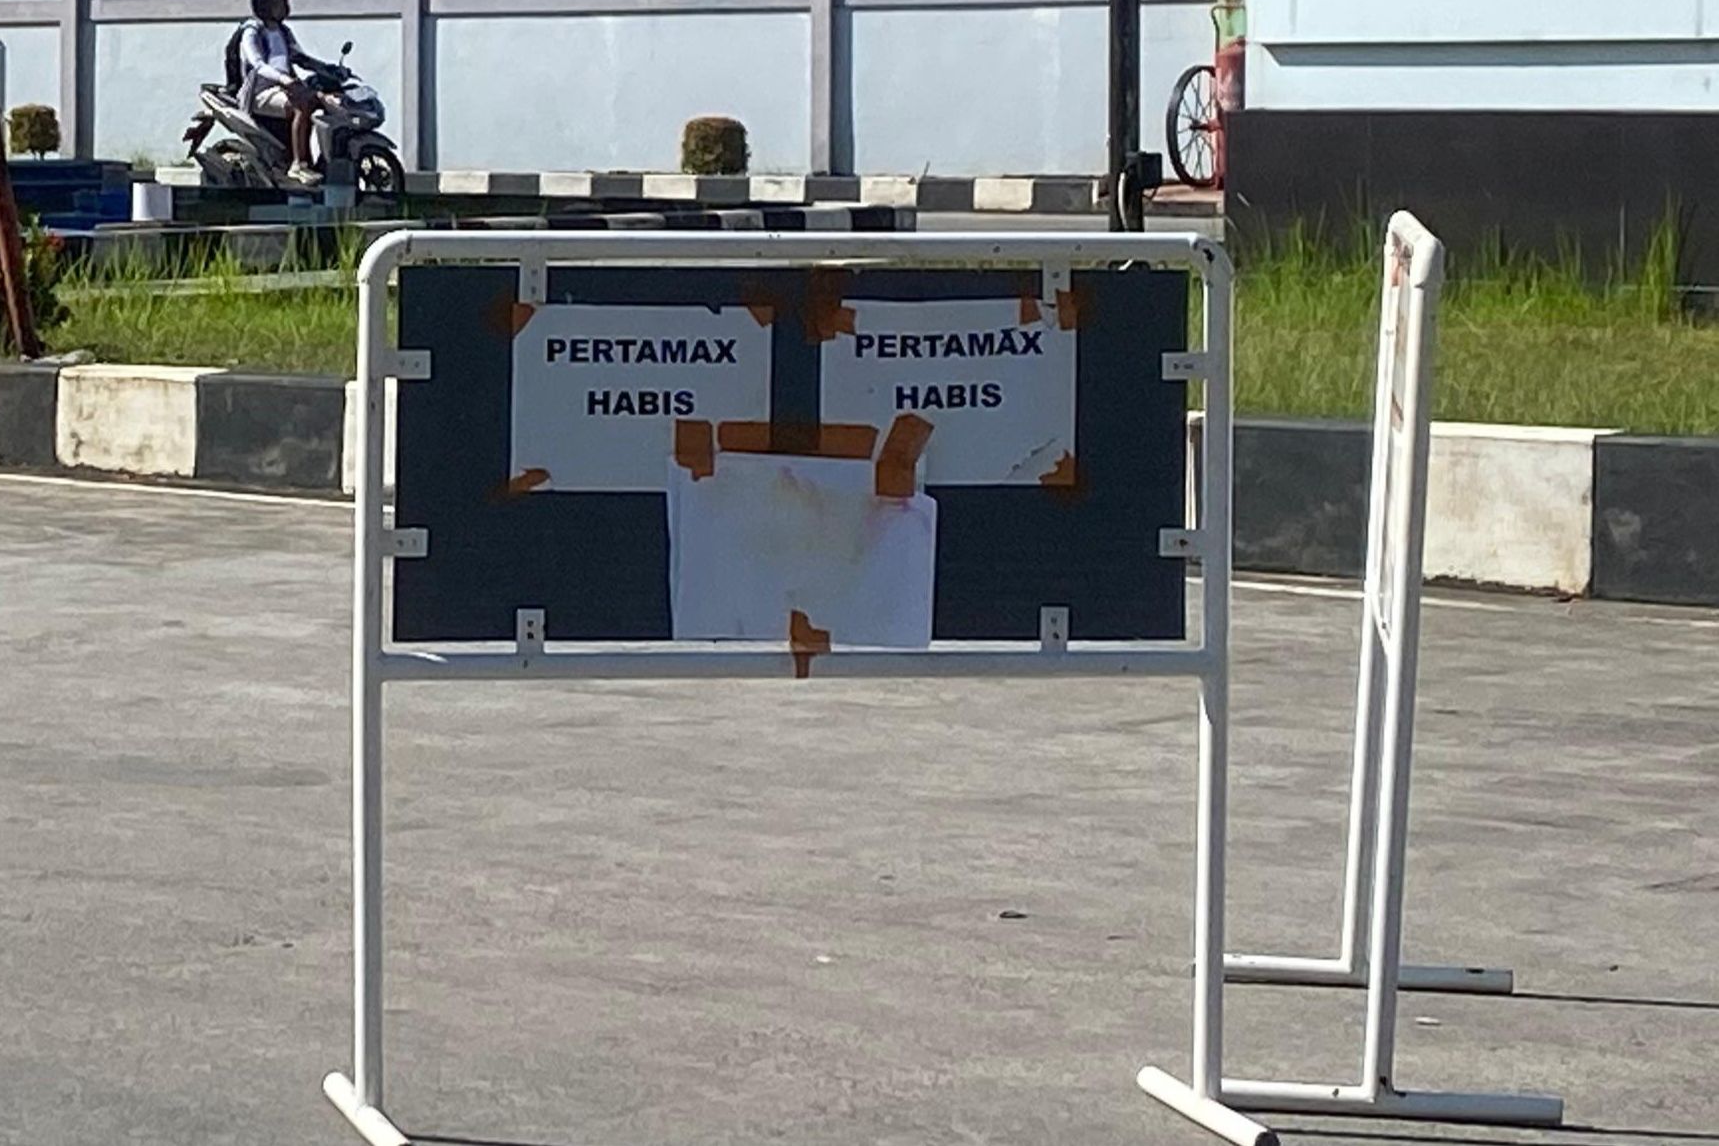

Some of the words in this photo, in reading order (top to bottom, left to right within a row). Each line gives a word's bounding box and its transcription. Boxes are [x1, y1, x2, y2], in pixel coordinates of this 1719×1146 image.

[546, 339, 737, 364] PERTAMAX
[855, 329, 1043, 358] PERTAMAX
[587, 390, 695, 416] HABIS
[895, 384, 1003, 410] HABIS
